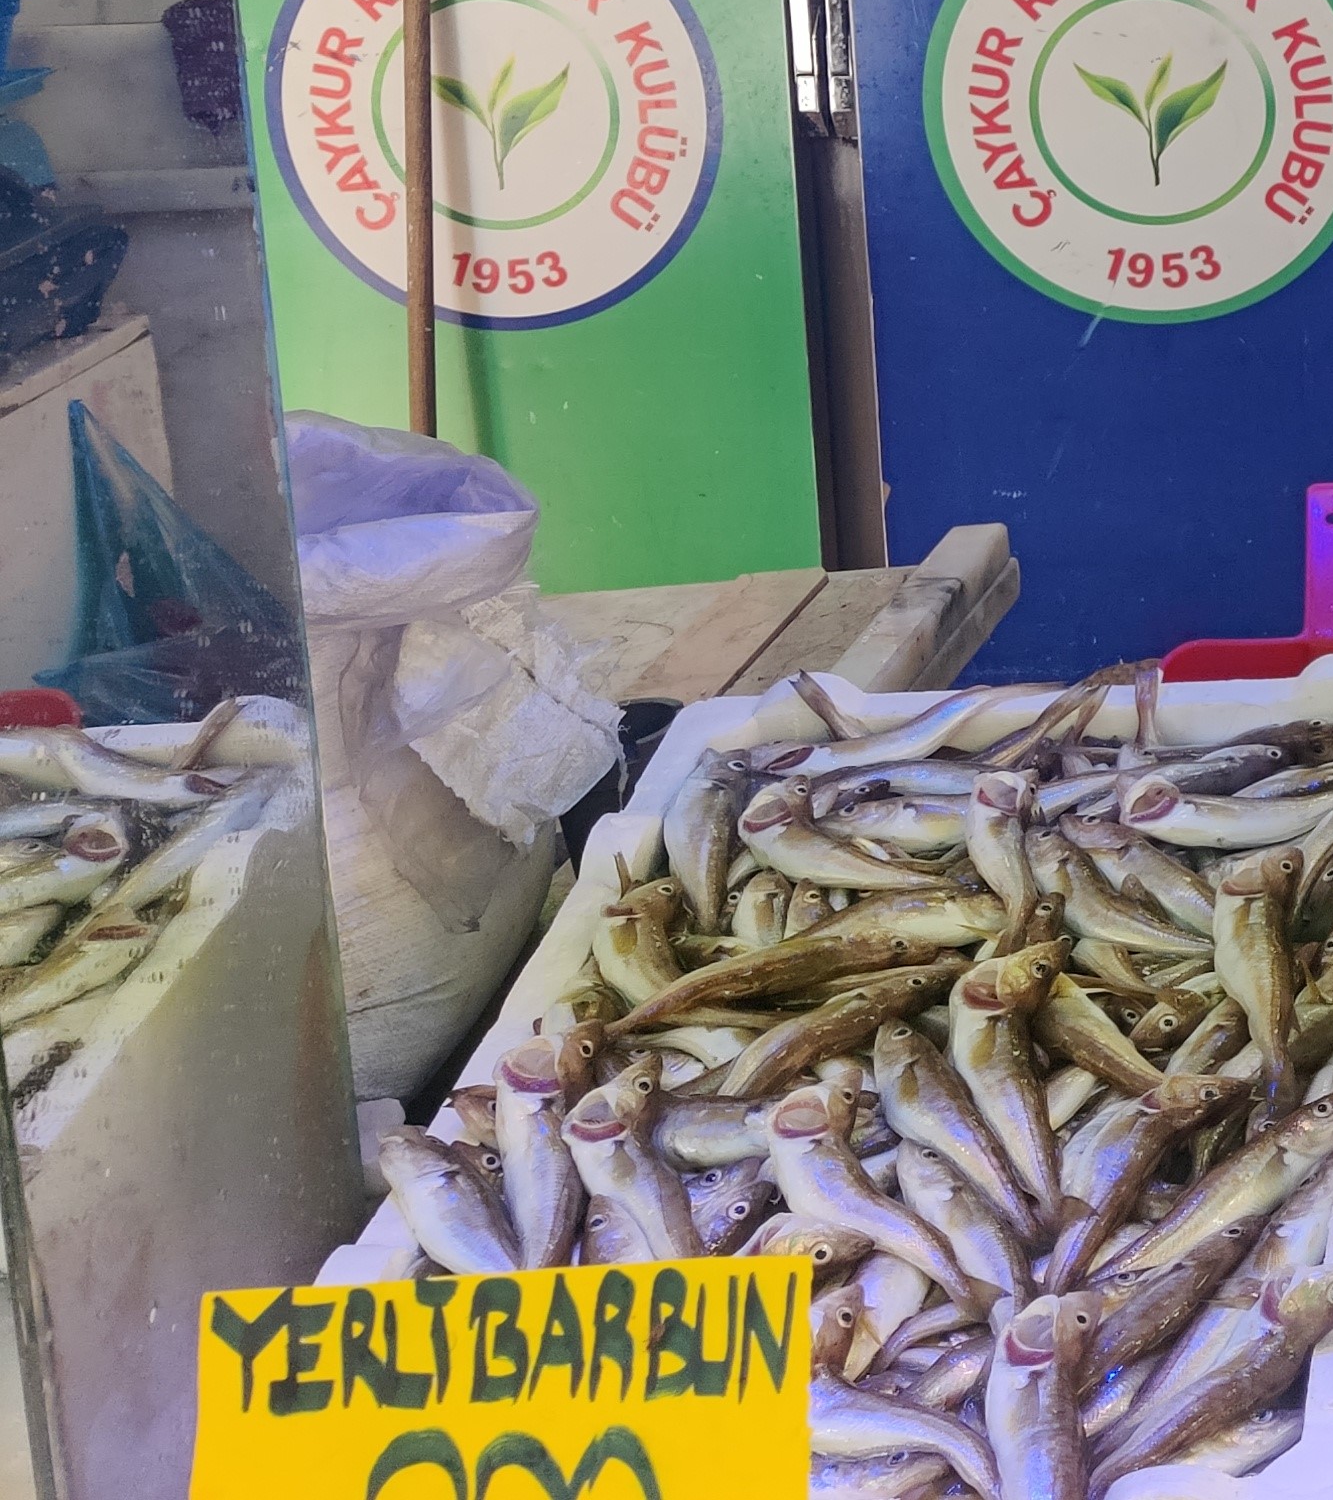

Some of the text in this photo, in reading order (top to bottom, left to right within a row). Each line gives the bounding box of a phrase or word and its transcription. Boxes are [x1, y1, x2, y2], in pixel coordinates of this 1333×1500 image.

[310, 26, 401, 231] ÇAYKUR
[608, 21, 688, 233] KULÜBÜ
[968, 27, 1057, 228] ÇAYKUR
[451, 250, 568, 295] 1953
[1106, 245, 1222, 289] 1953
[468, 1268, 797, 1406] BARBUN
